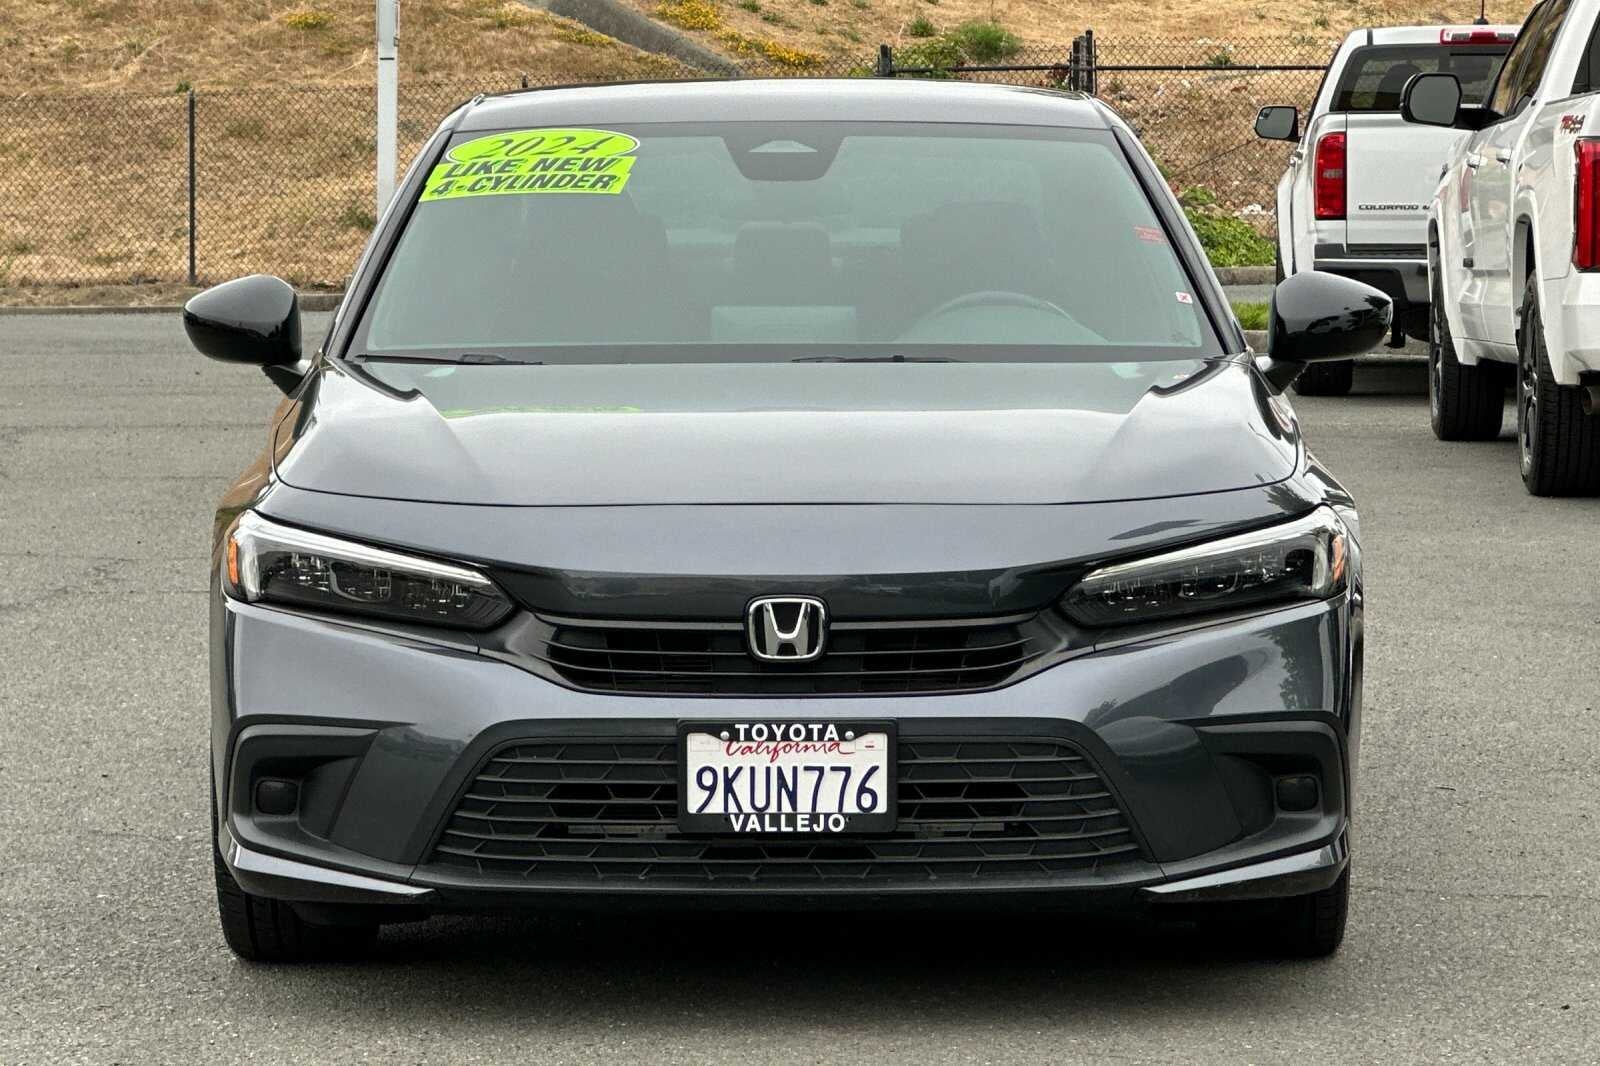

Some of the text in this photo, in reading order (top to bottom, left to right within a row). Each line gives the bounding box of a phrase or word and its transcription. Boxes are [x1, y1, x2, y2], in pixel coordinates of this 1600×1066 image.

[470, 135, 618, 160] 2024
[443, 157, 619, 178] LIKE NEW
[431, 173, 619, 195] 4-CYLINDER
[735, 723, 840, 742] TOYOTA
[724, 740, 856, 763] California
[695, 765, 880, 813] 9KUN776
[729, 813, 846, 832] VALLEJO
